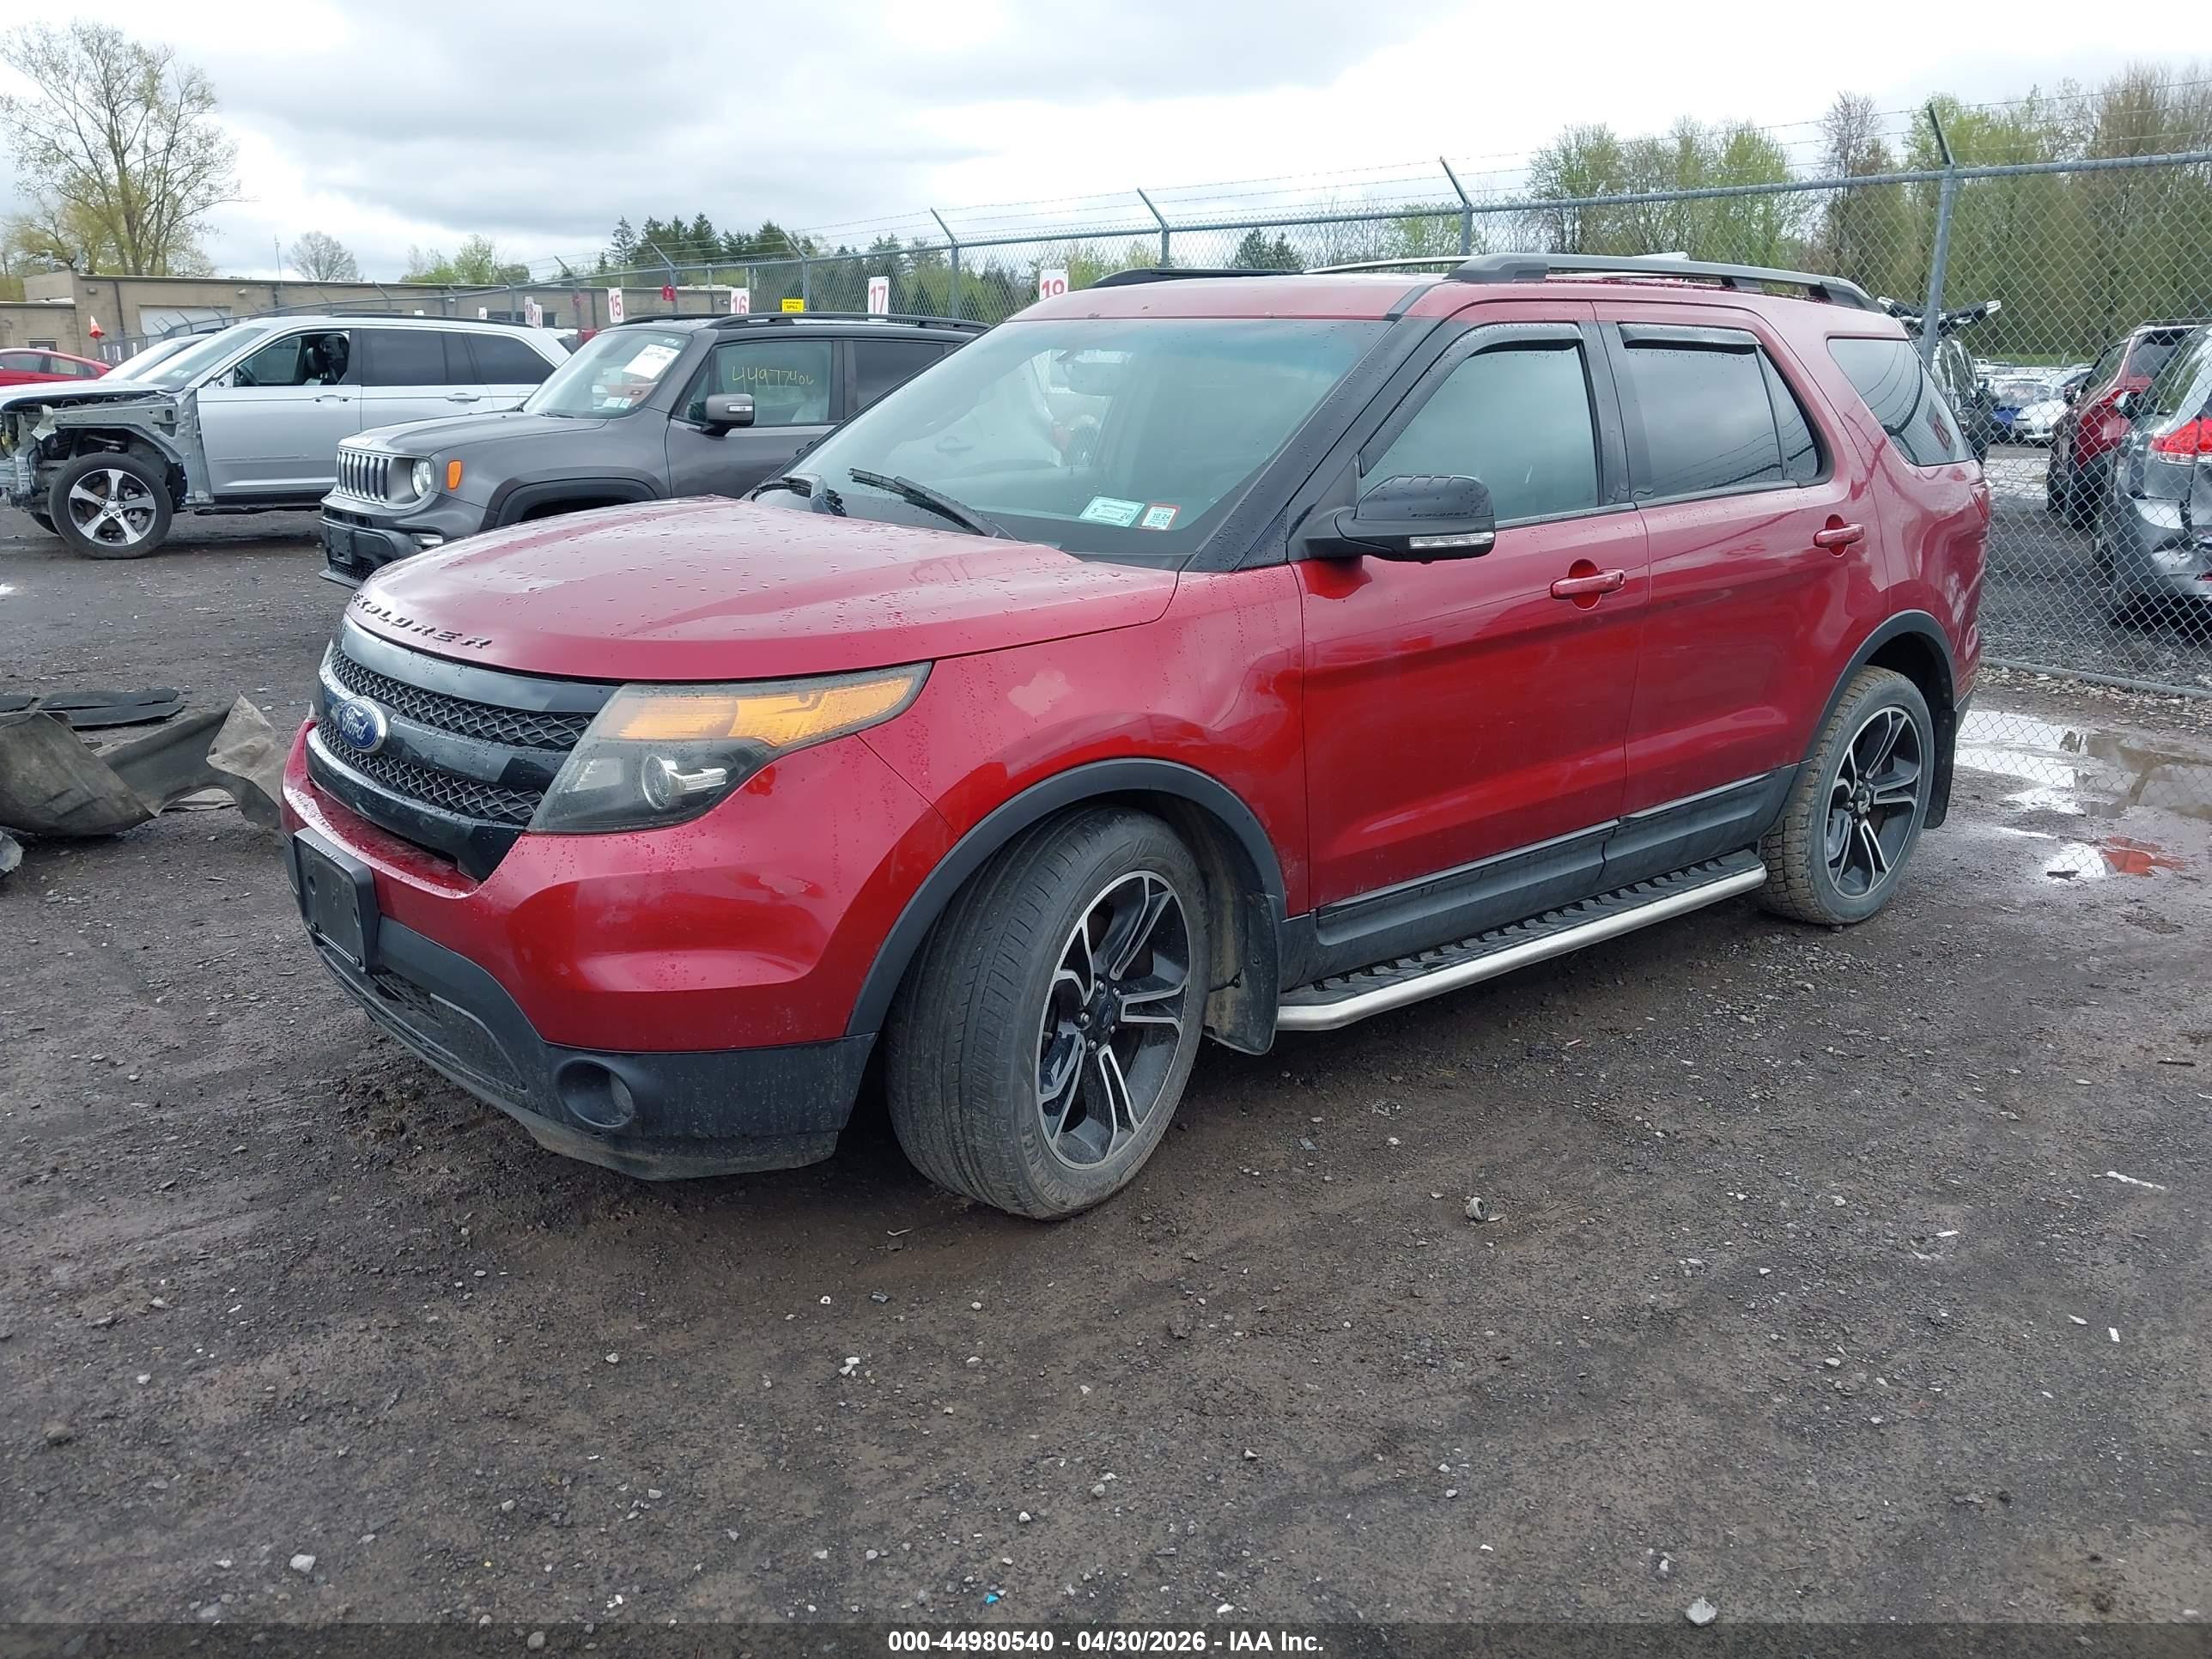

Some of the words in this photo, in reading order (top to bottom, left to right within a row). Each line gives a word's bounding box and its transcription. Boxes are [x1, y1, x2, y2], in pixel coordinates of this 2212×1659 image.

[611, 295, 622, 317] 15
[732, 295, 747, 313] 16
[870, 286, 885, 313] 17
[343, 706, 369, 740] Ford
